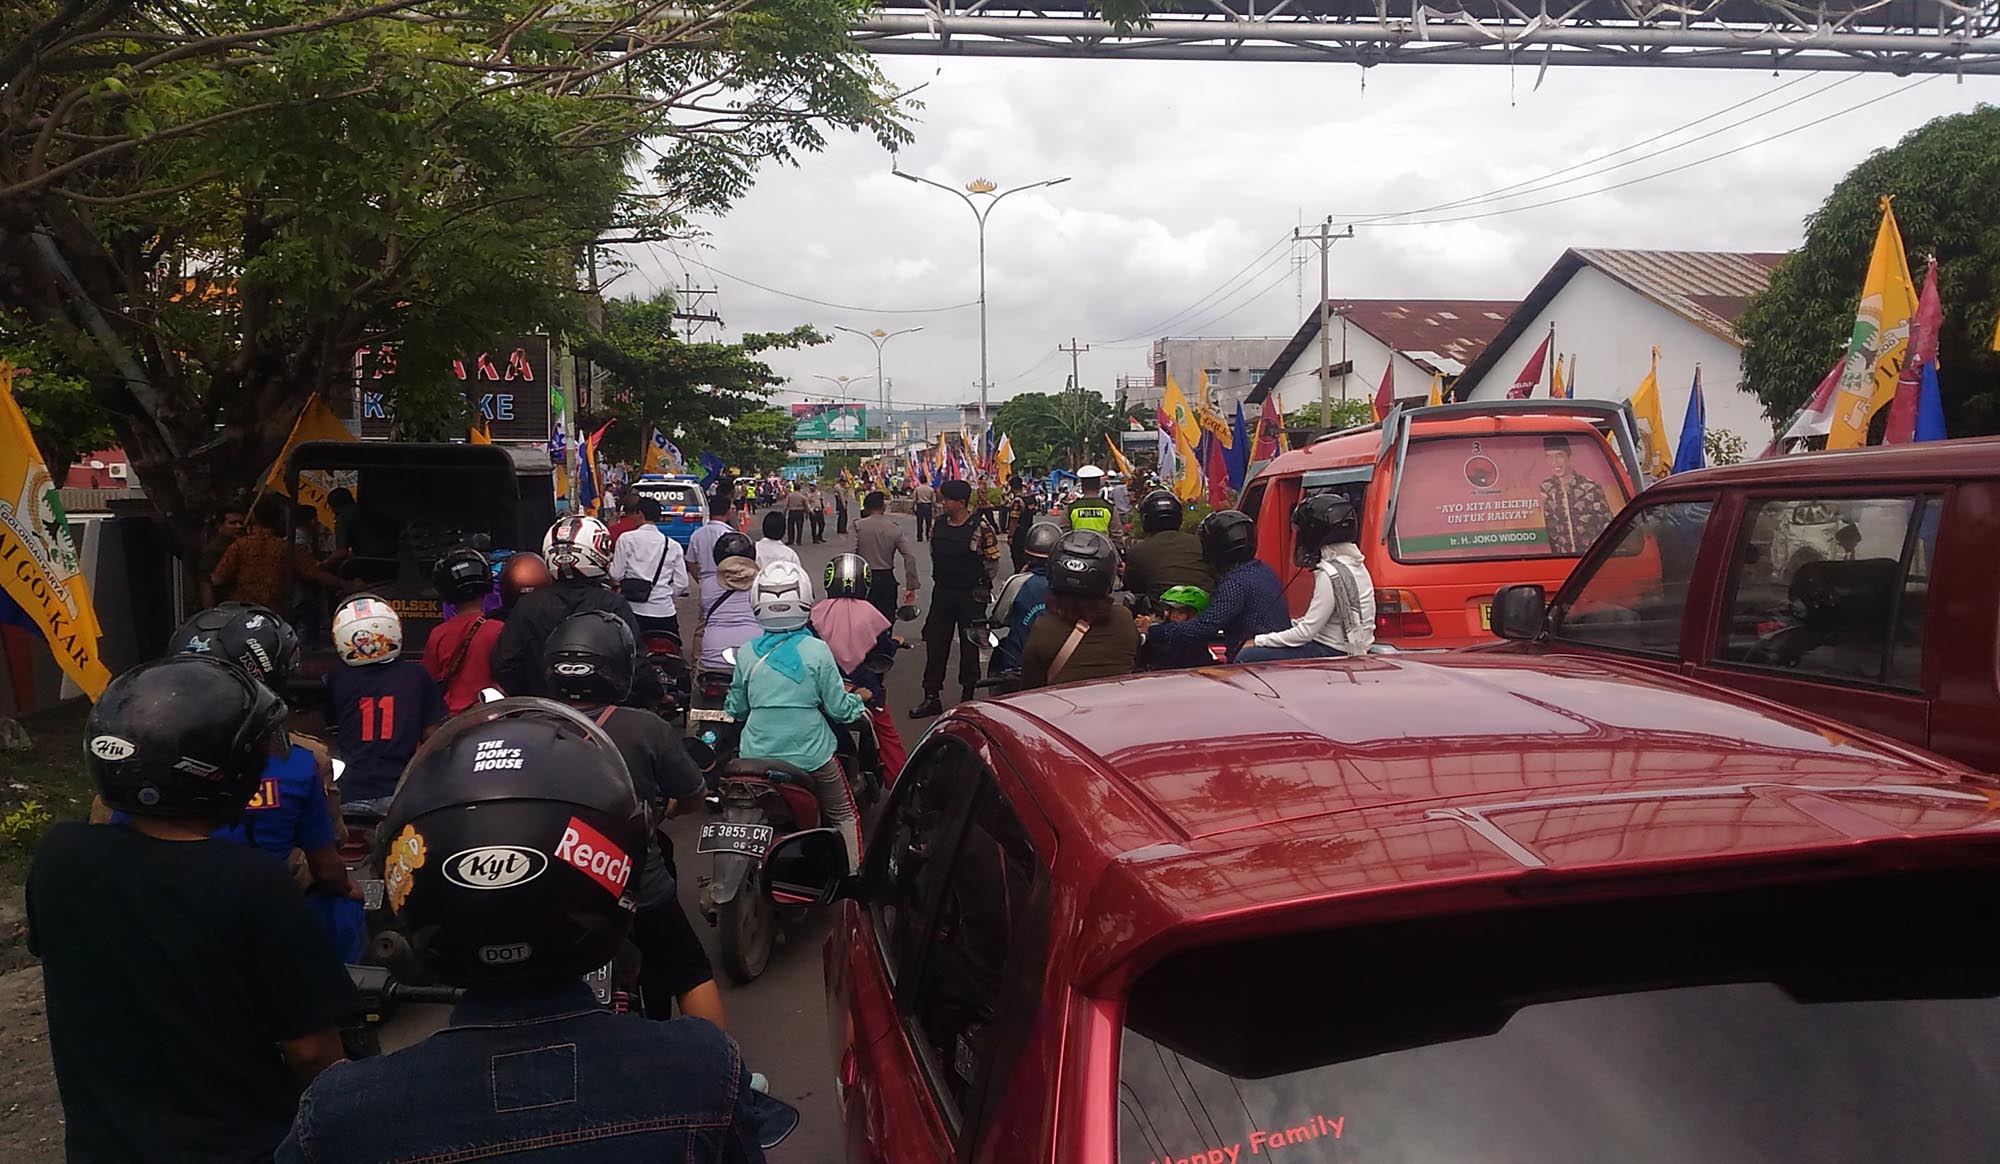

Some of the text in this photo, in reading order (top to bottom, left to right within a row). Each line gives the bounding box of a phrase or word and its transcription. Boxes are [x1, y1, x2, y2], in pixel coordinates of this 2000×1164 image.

[1467, 502, 1492, 511] KITA
[1495, 499, 1540, 510] BEKERJA
[1447, 513, 1485, 523] UNTUK
[1461, 536, 1472, 544] H.
[1473, 534, 1498, 543] JOKO
[1498, 532, 1537, 542] WIDODO
[40, 563, 65, 598] KARYA
[359, 695, 395, 741] 11
[96, 739, 125, 756] Hiu
[476, 740, 504, 751] THE
[475, 749, 521, 761] DON'S
[473, 758, 524, 772] HOUSE
[703, 826, 715, 838] BE
[554, 827, 632, 887] Reach
[464, 853, 526, 881] Kyt
[486, 946, 525, 961] DOT
[1249, 1114, 1345, 1154] Family
